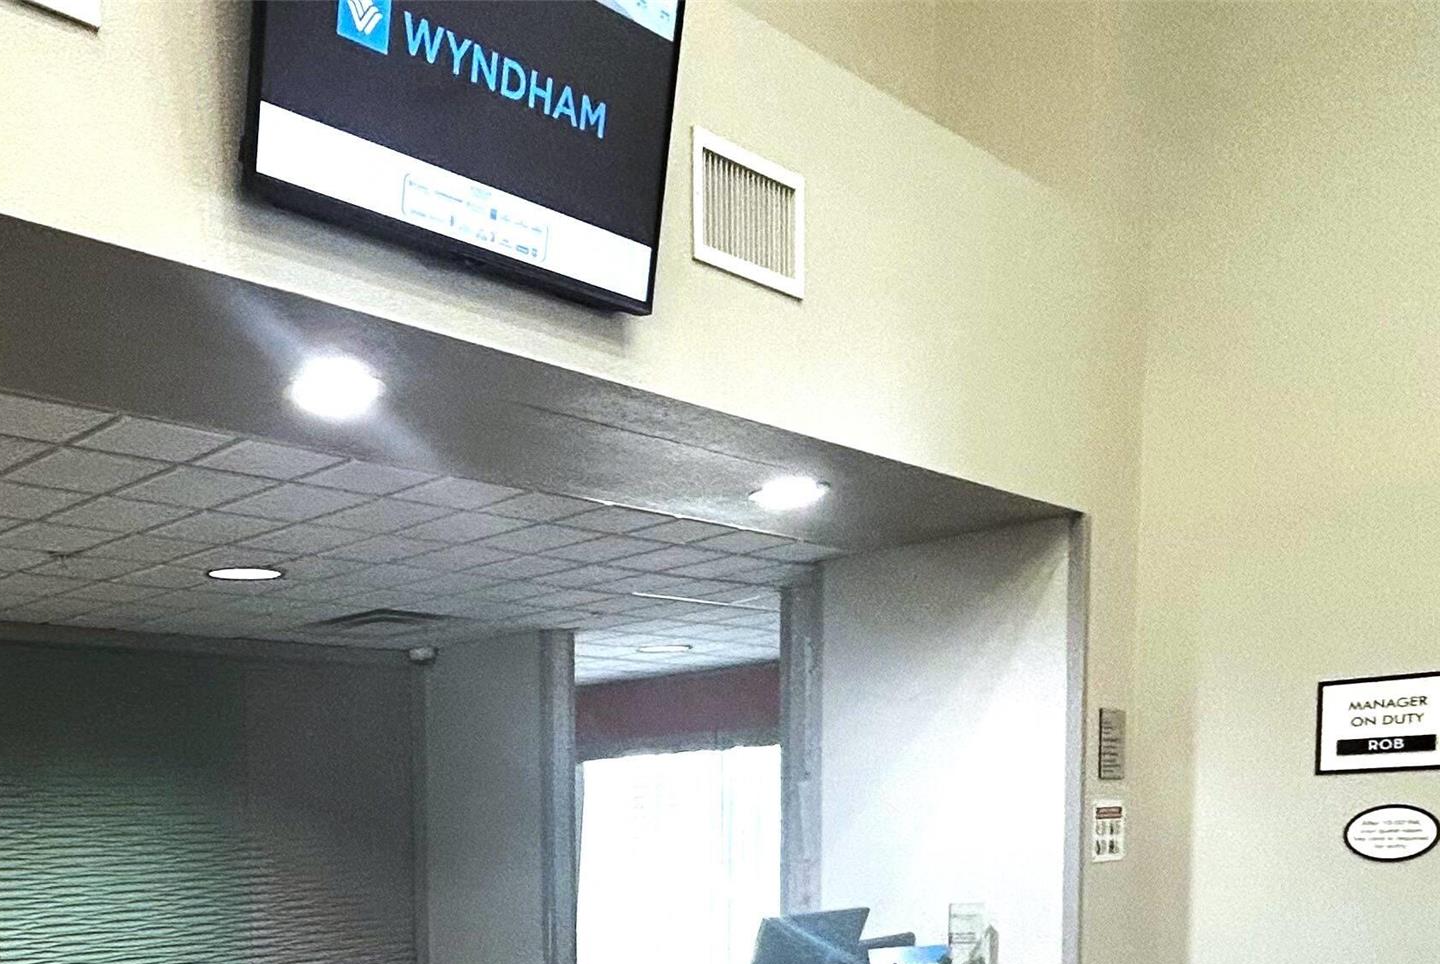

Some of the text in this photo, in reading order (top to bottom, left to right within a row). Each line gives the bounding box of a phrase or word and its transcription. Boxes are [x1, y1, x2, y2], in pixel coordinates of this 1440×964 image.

[404, 11, 606, 139] WYNDHAM
[1348, 695, 1428, 711] MANAGER
[1350, 712, 1424, 727] ON DUTY
[1368, 738, 1404, 751] ROB
